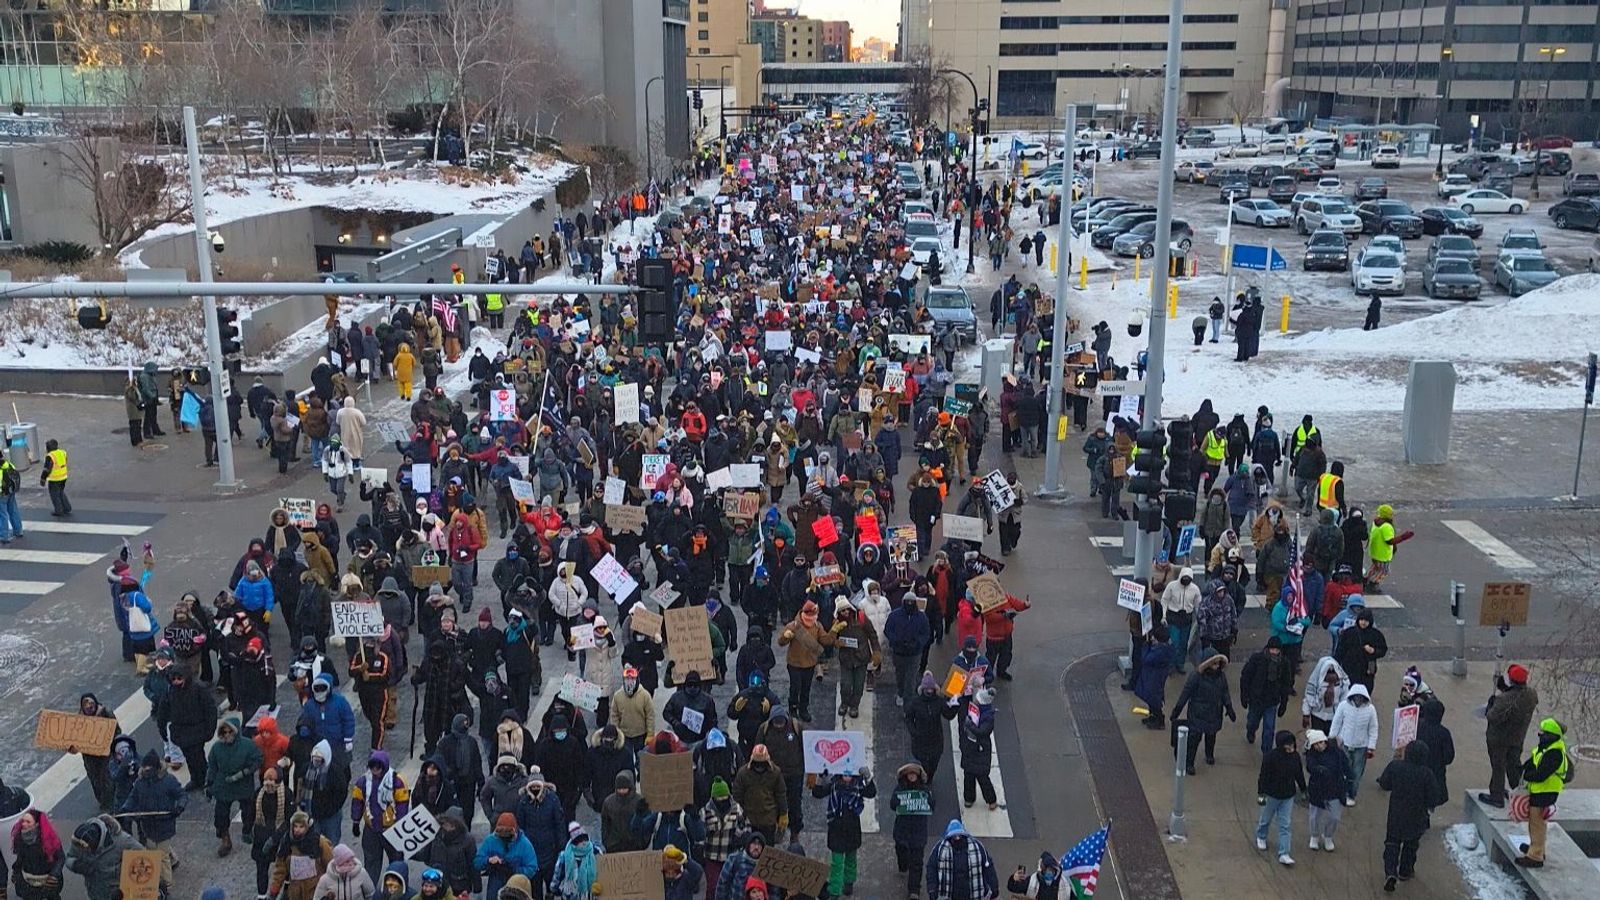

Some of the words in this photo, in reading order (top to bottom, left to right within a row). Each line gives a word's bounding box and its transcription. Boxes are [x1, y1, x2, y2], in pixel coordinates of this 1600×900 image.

[1101, 384, 1126, 392] Nicollet
[501, 404, 514, 412] ICE
[645, 464, 656, 474] ICE
[988, 470, 1008, 491] End
[999, 487, 1012, 507] the
[280, 497, 294, 509] You
[1120, 588, 1136, 598] GOSH
[1487, 584, 1525, 596] ICE
[1119, 593, 1142, 605] DARNIT
[334, 603, 356, 614] END
[336, 612, 369, 625] STATE
[164, 626, 199, 639] STAND
[338, 623, 384, 636] VIOLENCE
[393, 810, 428, 839] ICE
[403, 823, 436, 852] OUT
[791, 863, 822, 883] OUT
